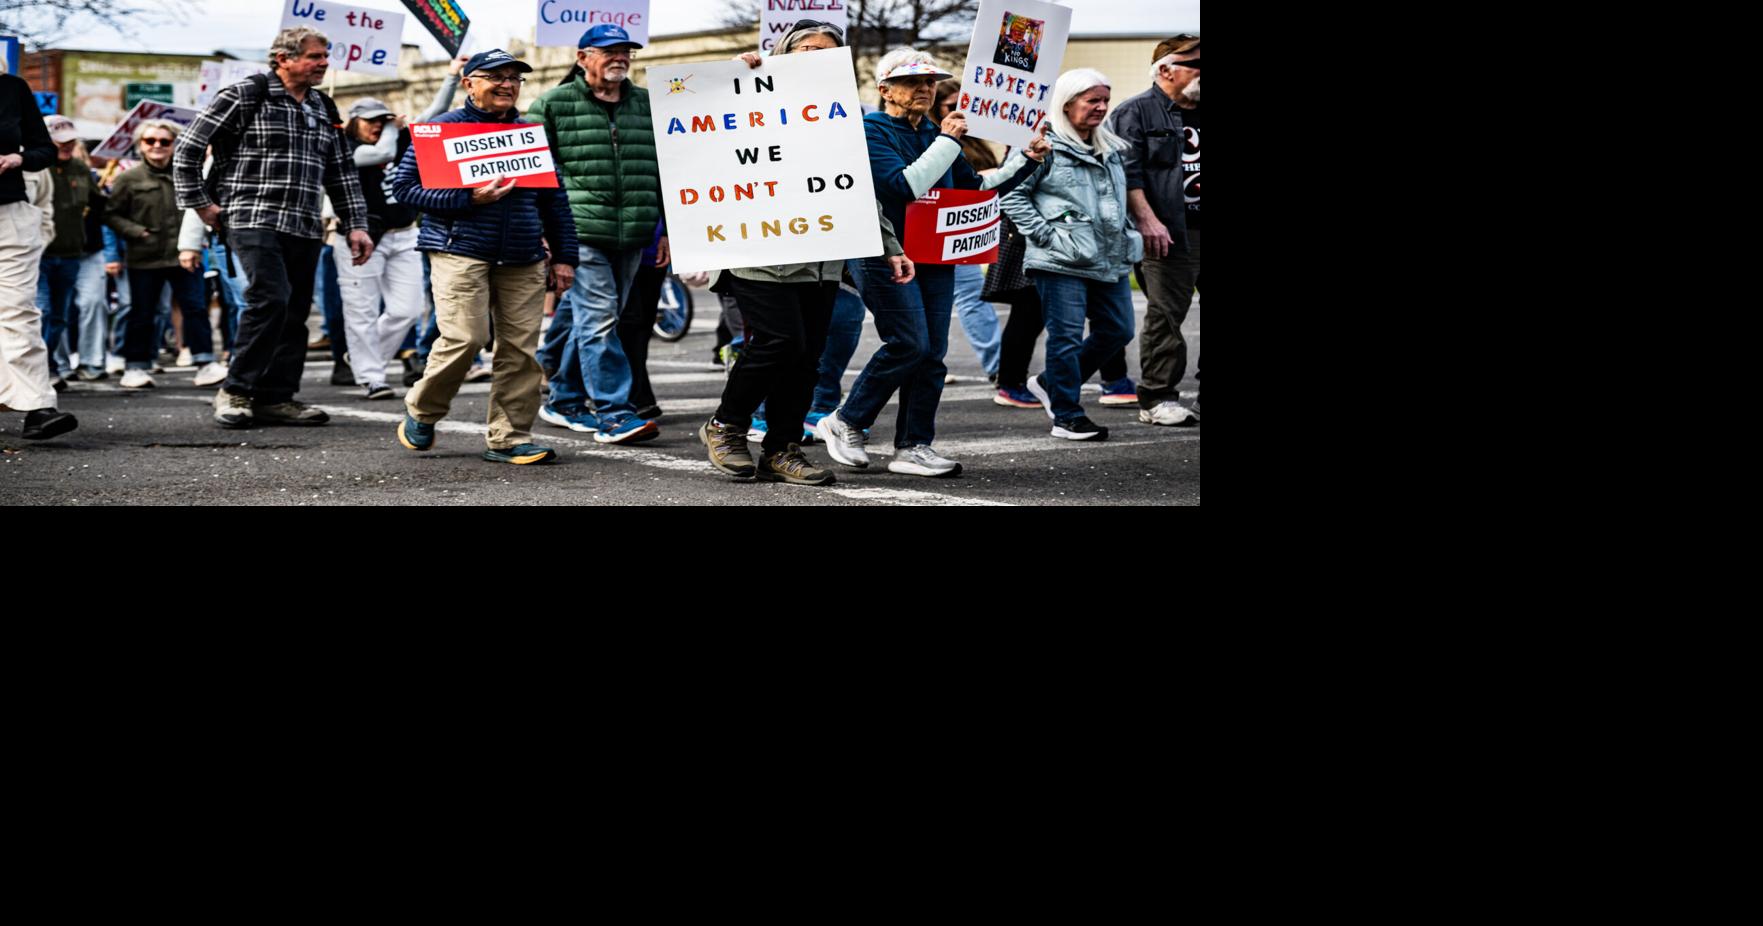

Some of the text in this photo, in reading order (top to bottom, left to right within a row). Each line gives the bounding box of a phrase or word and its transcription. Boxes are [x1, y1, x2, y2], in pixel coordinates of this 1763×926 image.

[292, 0, 384, 30] We the
[541, 0, 642, 28] Courage
[1004, 52, 1029, 68] KINGS
[733, 75, 774, 95] IN
[974, 66, 1050, 102] PROTECT
[667, 101, 847, 135] AMERICA
[454, 131, 535, 155] DISSENT IS
[735, 145, 782, 165] WE
[470, 155, 542, 178] PATRIOTIC
[679, 173, 854, 205] DON'T DO
[706, 214, 834, 242] KINGS
[946, 203, 993, 227] DISSENT
[952, 227, 998, 254] PATRIOTIC
